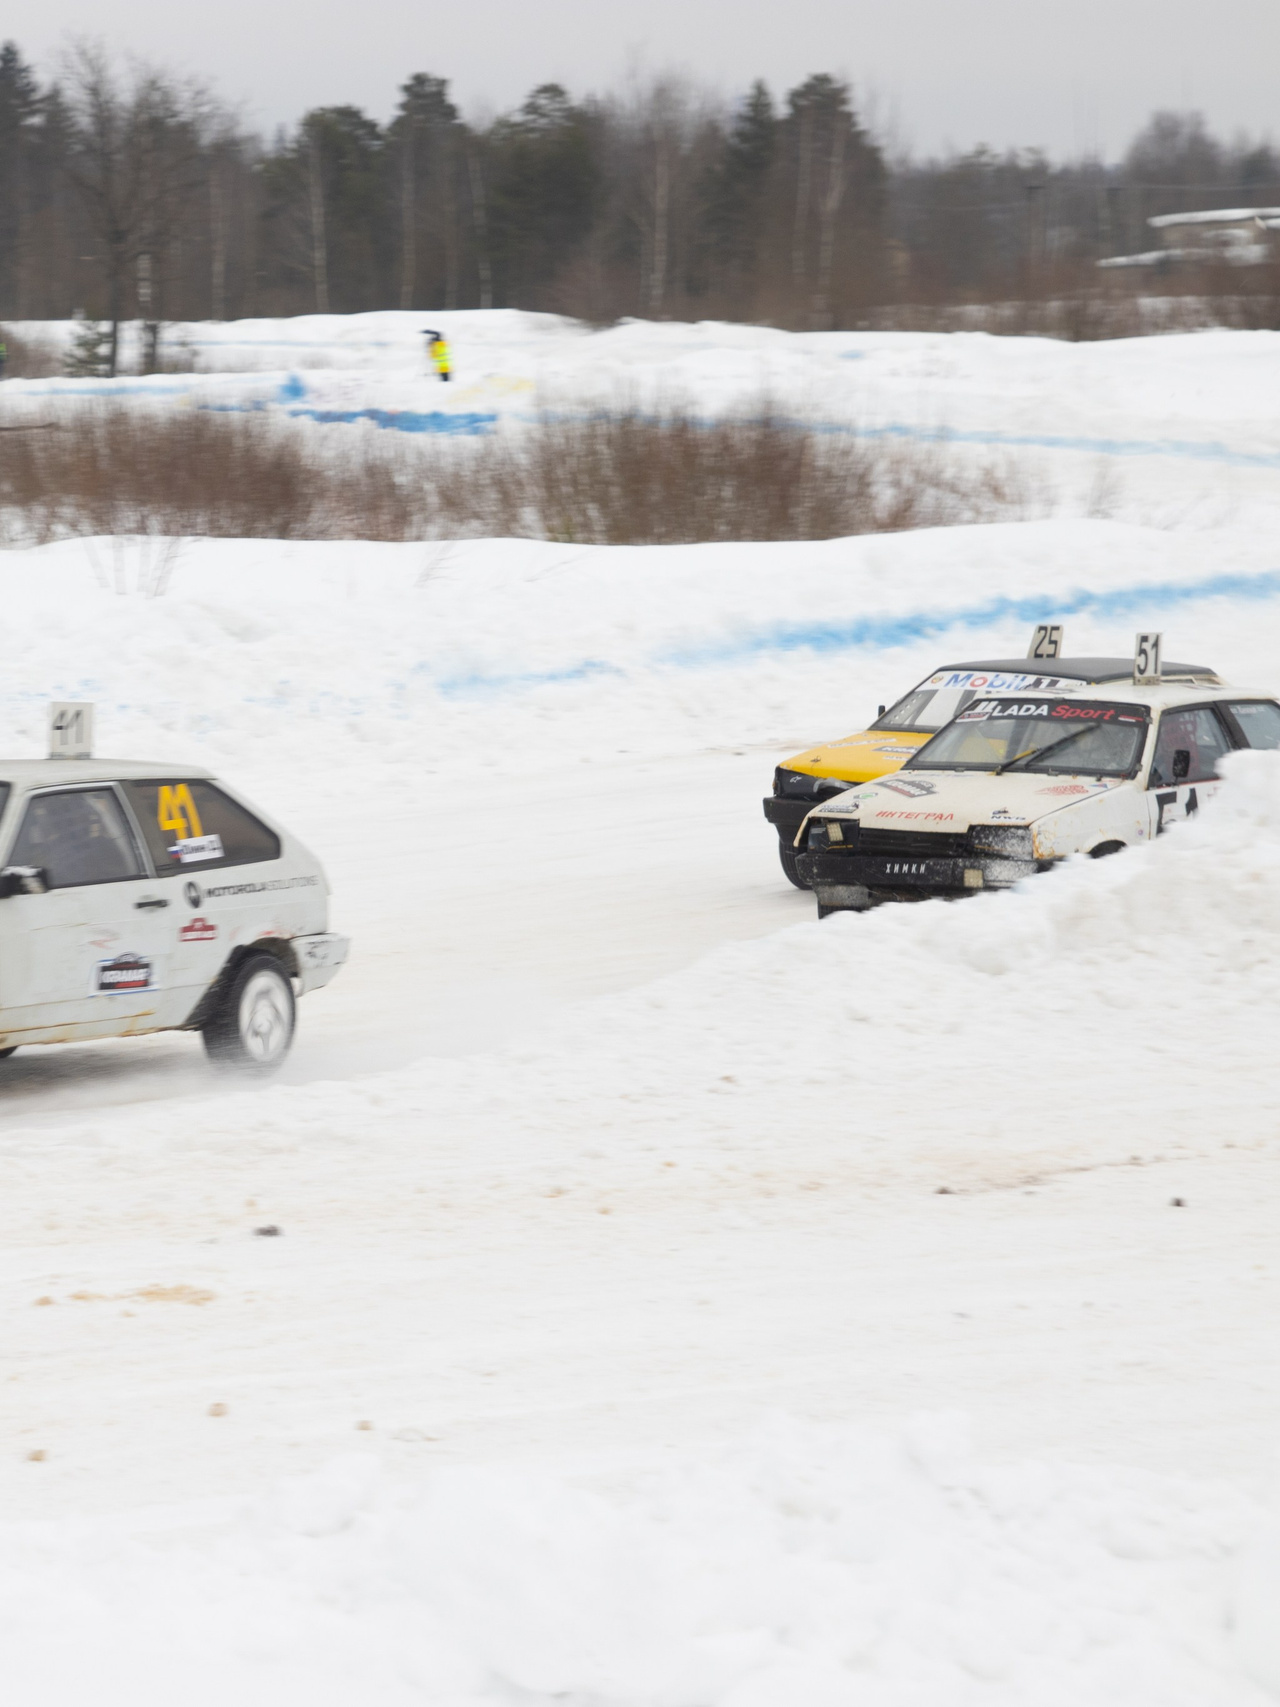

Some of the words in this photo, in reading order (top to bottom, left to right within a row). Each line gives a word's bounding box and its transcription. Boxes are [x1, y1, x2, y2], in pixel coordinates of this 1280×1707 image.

[1034, 626, 1060, 658] 25
[1137, 635, 1160, 676] 51
[945, 674, 1027, 691] Mobil
[992, 704, 1049, 717] LADA
[1051, 705, 1116, 721] Sport
[52, 710, 83, 745] 41
[157, 783, 204, 840] 41
[875, 811, 954, 821] ИНТЕГРАЛ
[885, 863, 926, 874] ХИМКИ
